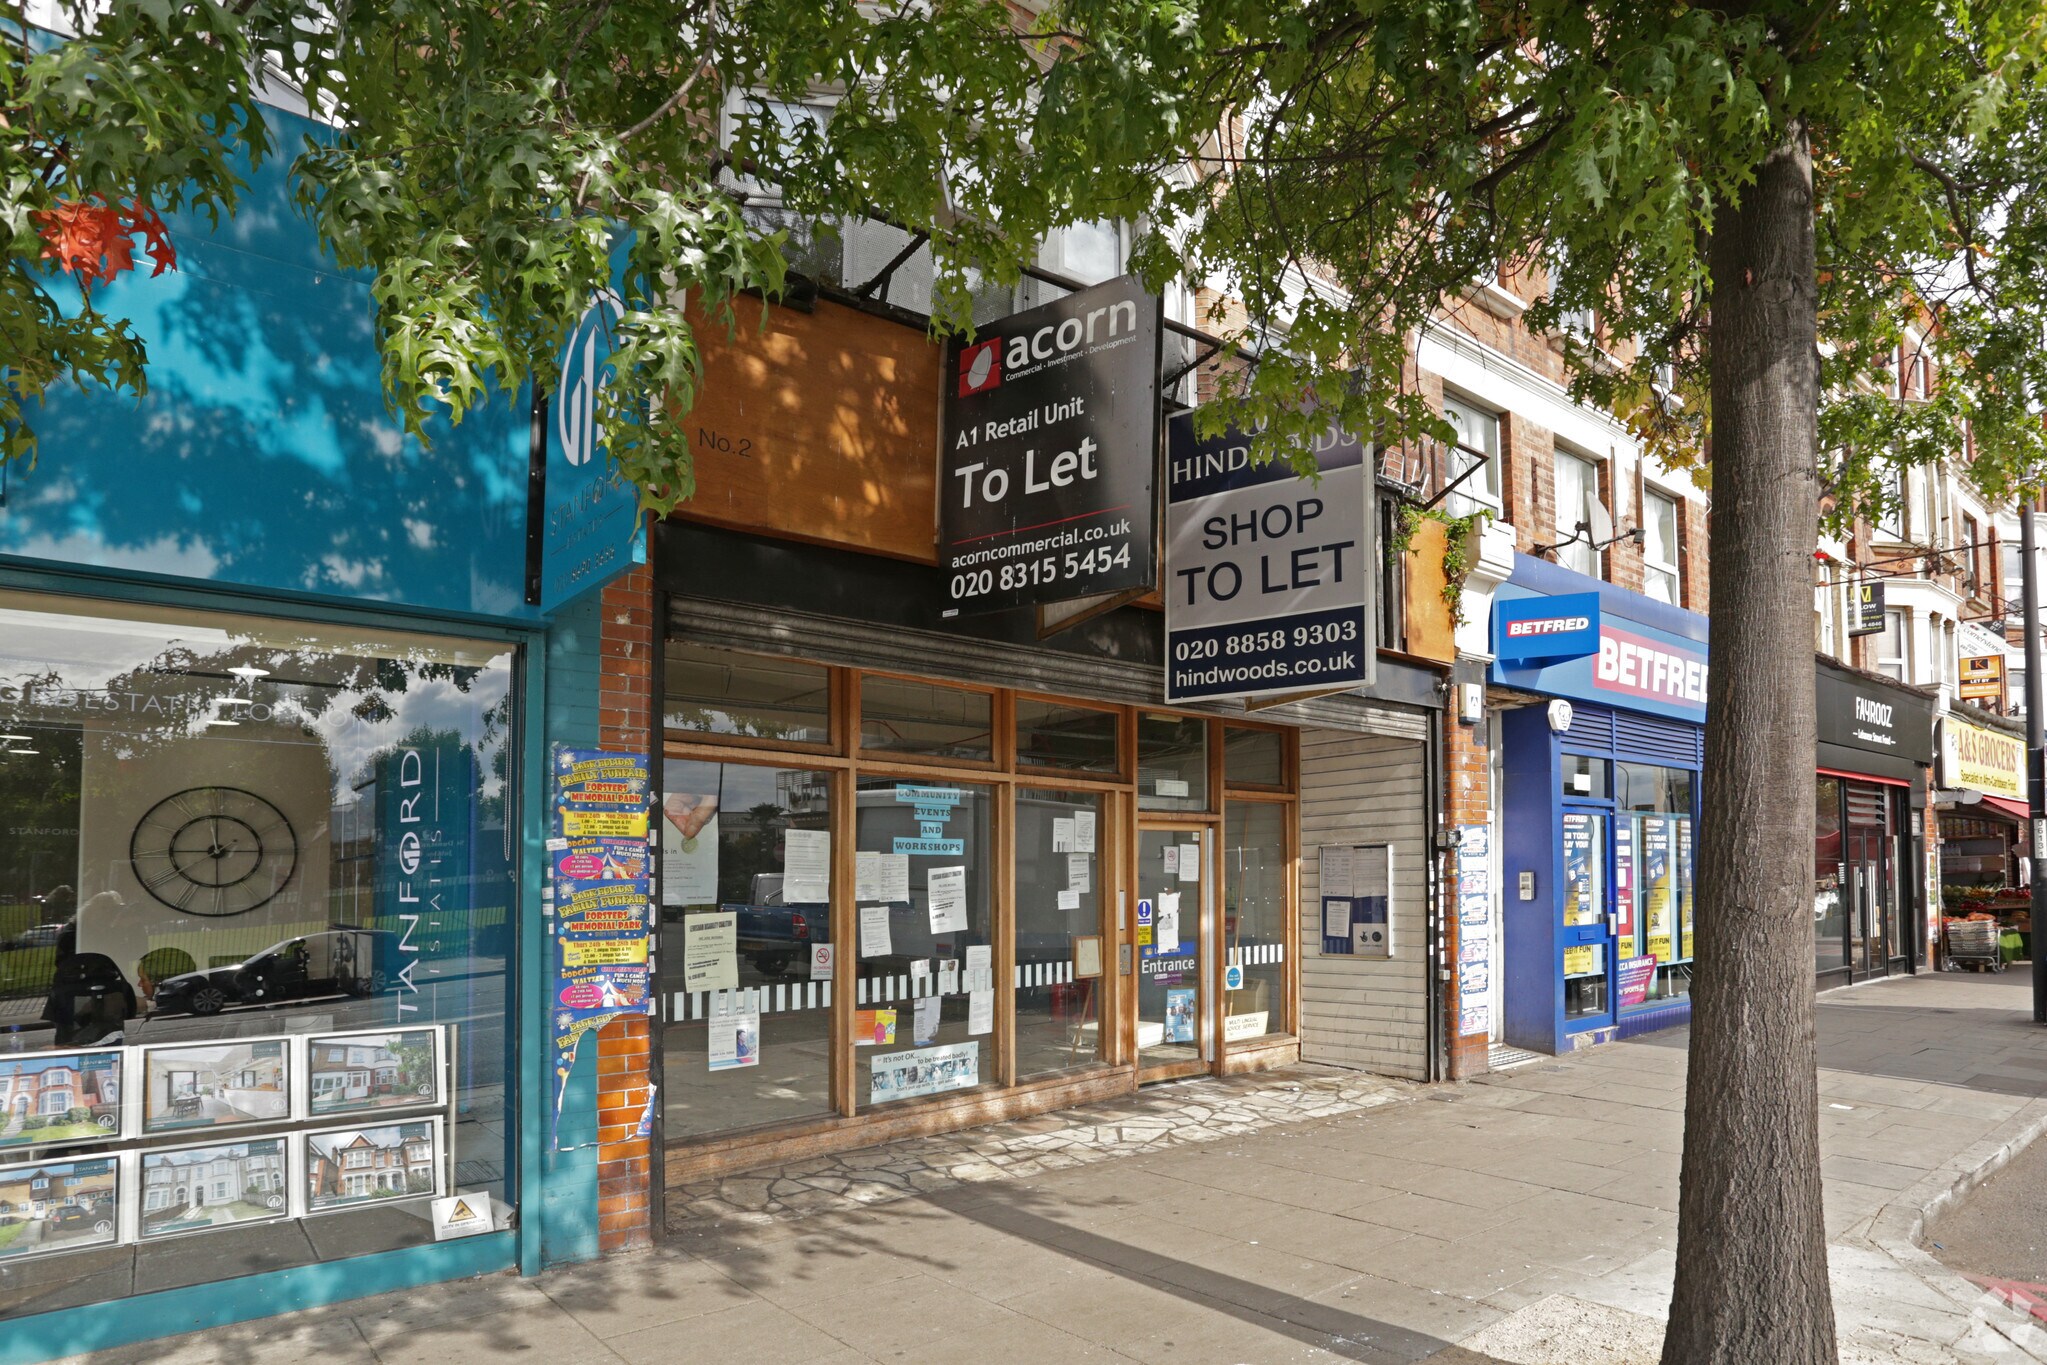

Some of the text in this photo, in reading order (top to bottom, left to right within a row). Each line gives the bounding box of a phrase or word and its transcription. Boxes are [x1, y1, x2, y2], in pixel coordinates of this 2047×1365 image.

[1006, 299, 1137, 370] acorn
[1005, 335, 1137, 382] Commercial Investment Development
[956, 396, 1084, 450] A1 Retail Unit
[700, 427, 752, 457] No.2
[1173, 426, 1357, 485] HINDDS
[954, 436, 1098, 509] To Let
[551, 463, 624, 537] STANFOR
[1202, 498, 1324, 550] SHOP
[951, 518, 1131, 568] acorncommercial.co.uk
[950, 542, 1131, 599] 020 8315 5454
[1177, 541, 1355, 606] TO LET
[1509, 617, 1590, 635] BETFRED
[1175, 620, 1357, 661] 020 8858 9303
[1176, 650, 1356, 688] hindwoods.co.uk
[1856, 696, 1892, 728] FAYROOZ
[1958, 727, 2016, 773] A&S GROCERS
[572, 758, 636, 771] BANK HOLIDAY
[558, 767, 648, 786] FAMILY FUNFAIR
[585, 782, 628, 793] FORSTERS
[897, 789, 959, 800] COMMUNITY
[571, 793, 642, 803] MEMORIAL PARK
[914, 808, 951, 817] EVENTS
[921, 826, 942, 834] AND
[566, 837, 596, 848] ODGEMS
[895, 841, 960, 852] WORKSHOPS
[572, 884, 636, 901] BANK HOLIDAY
[558, 894, 648, 918] FAMILY FUNFAIR
[585, 911, 628, 920] FORSTERS
[571, 921, 641, 930] MEMORIAL PARK
[1579, 945, 1591, 953] FUN
[1141, 959, 1195, 974] Entrance
[1628, 957, 1653, 969] INSURANCE
[561, 967, 596, 979] DODGEMS
[932, 1053, 951, 1061] treated
[952, 1051, 968, 1060] badly!
